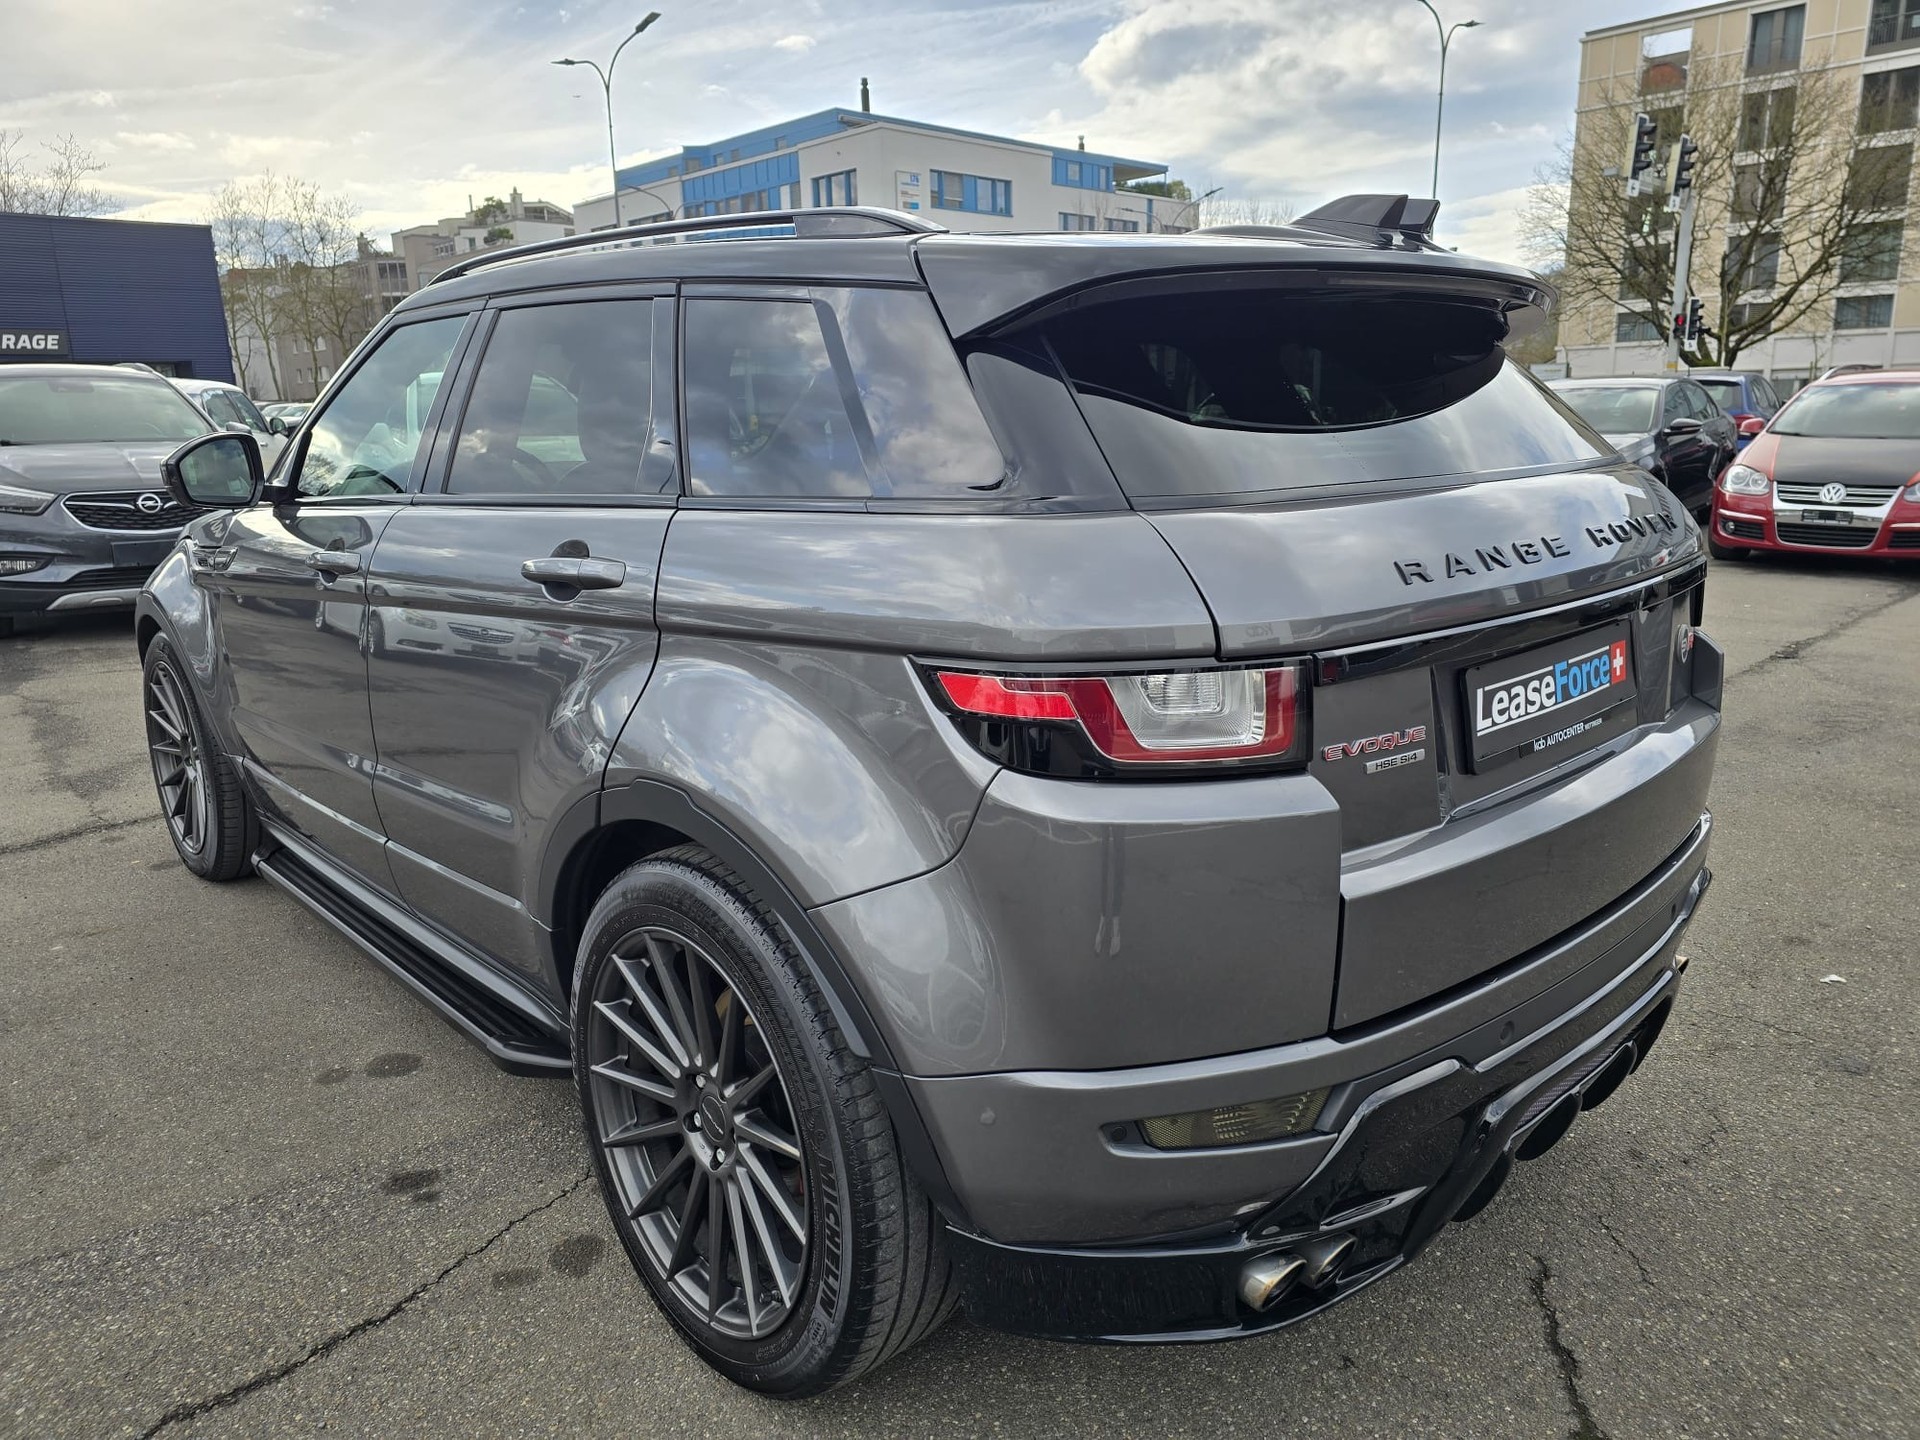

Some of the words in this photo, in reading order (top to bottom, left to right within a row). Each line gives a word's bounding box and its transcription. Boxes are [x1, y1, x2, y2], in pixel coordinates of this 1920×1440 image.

[1393, 536, 1571, 585] RANGE
[1585, 511, 1680, 548] ROVER
[1476, 652, 1610, 732] LeaseForce
[1322, 726, 1426, 760] EVOQUE
[1547, 723, 1584, 746] AUTOCENTER
[1375, 760, 1398, 771] HSE
[1400, 753, 1418, 764] Si4
[817, 1153, 842, 1320] MICHELIN
